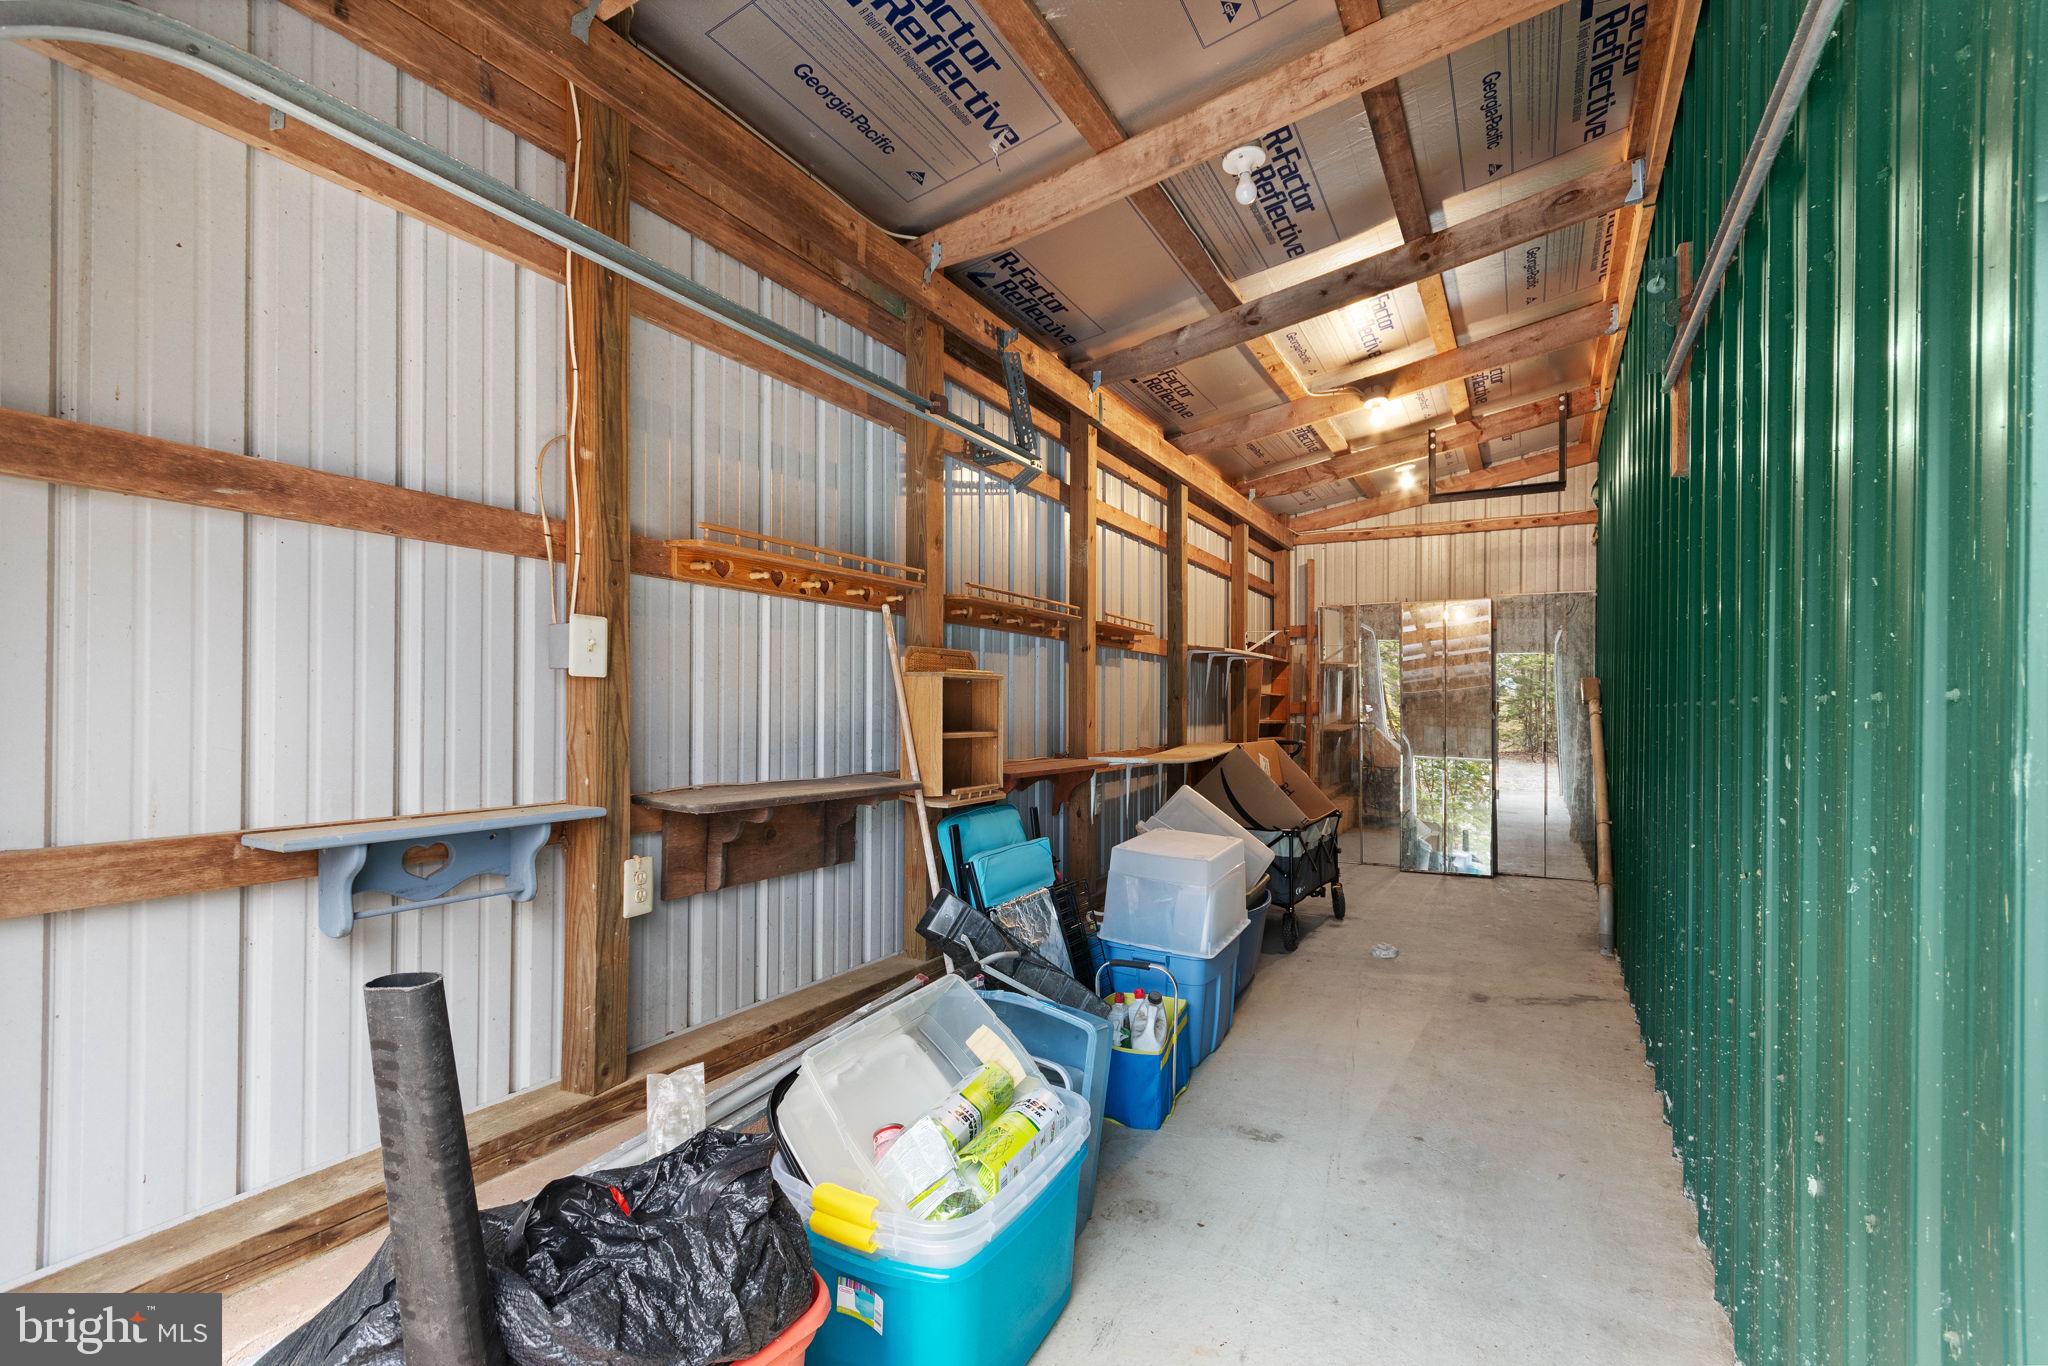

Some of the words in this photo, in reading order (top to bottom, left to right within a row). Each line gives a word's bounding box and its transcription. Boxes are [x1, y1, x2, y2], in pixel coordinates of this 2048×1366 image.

[863, 10, 881, 30] Rigid
[877, 25, 891, 41] Foil
[886, 36, 905, 56] Faced
[870, 0, 1020, 149] Reflective
[1584, 3, 1630, 142] Reflective
[1262, 124, 1315, 213] R-Factor
[1250, 163, 1306, 258] Reflective
[991, 251, 1069, 313] R-Factor
[992, 279, 1079, 345] Reflective
[1143, 377, 1194, 419] Reflective
